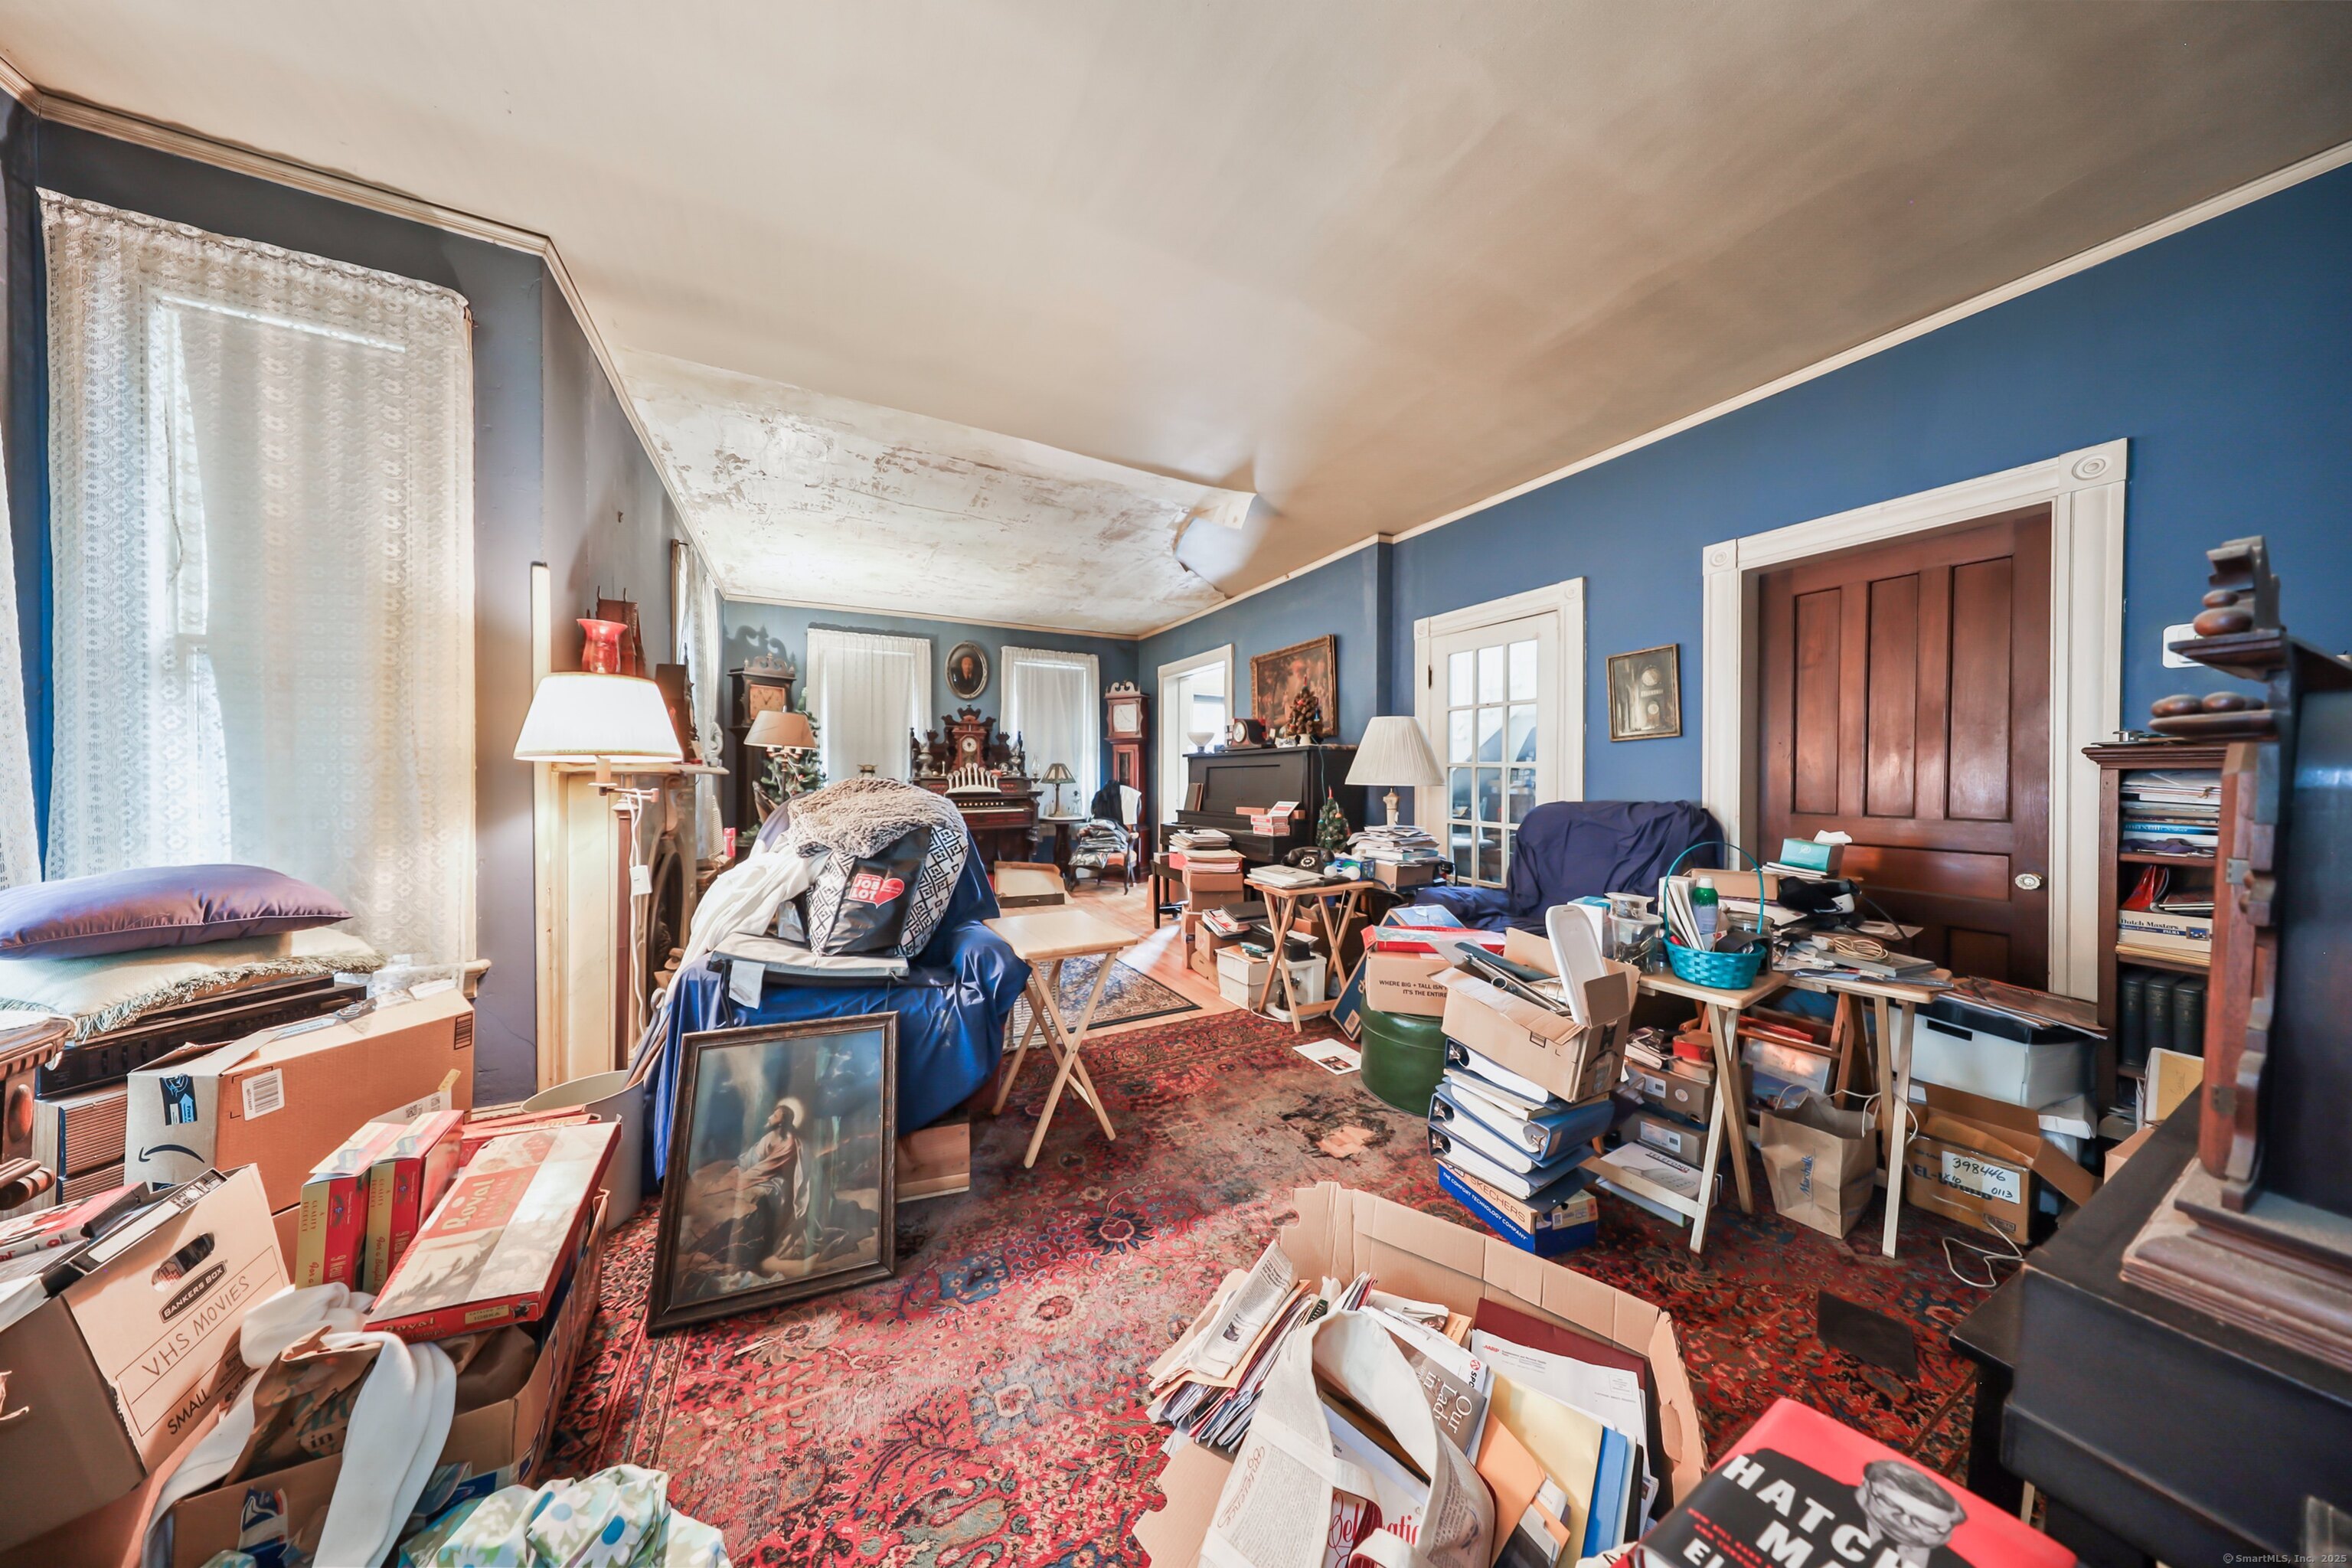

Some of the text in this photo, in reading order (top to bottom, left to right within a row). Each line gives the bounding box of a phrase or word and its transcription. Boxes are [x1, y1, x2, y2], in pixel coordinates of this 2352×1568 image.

[851, 888, 877, 900] LOT
[854, 879, 880, 890] JOB
[1648, 1152, 1690, 1171] TELEFONO
[1952, 1158, 2006, 1181] 398446
[442, 1178, 496, 1230] Royal
[1471, 1176, 1526, 1223] SKECHERS
[1991, 1187, 2013, 1198] 0113
[1451, 1178, 1472, 1197] COMFORT
[1471, 1194, 1502, 1220] TECHNOLOGY
[1502, 1218, 1527, 1240] COMPANY
[329, 1262, 347, 1278] New
[163, 1266, 224, 1318] BANKERS BOX
[142, 1334, 190, 1376] VHS
[193, 1276, 250, 1336] MOVIES
[1423, 1370, 1441, 1388] in
[167, 1388, 211, 1435] SMALL
[1447, 1396, 1472, 1433] Our
[310, 1432, 333, 1449] in
